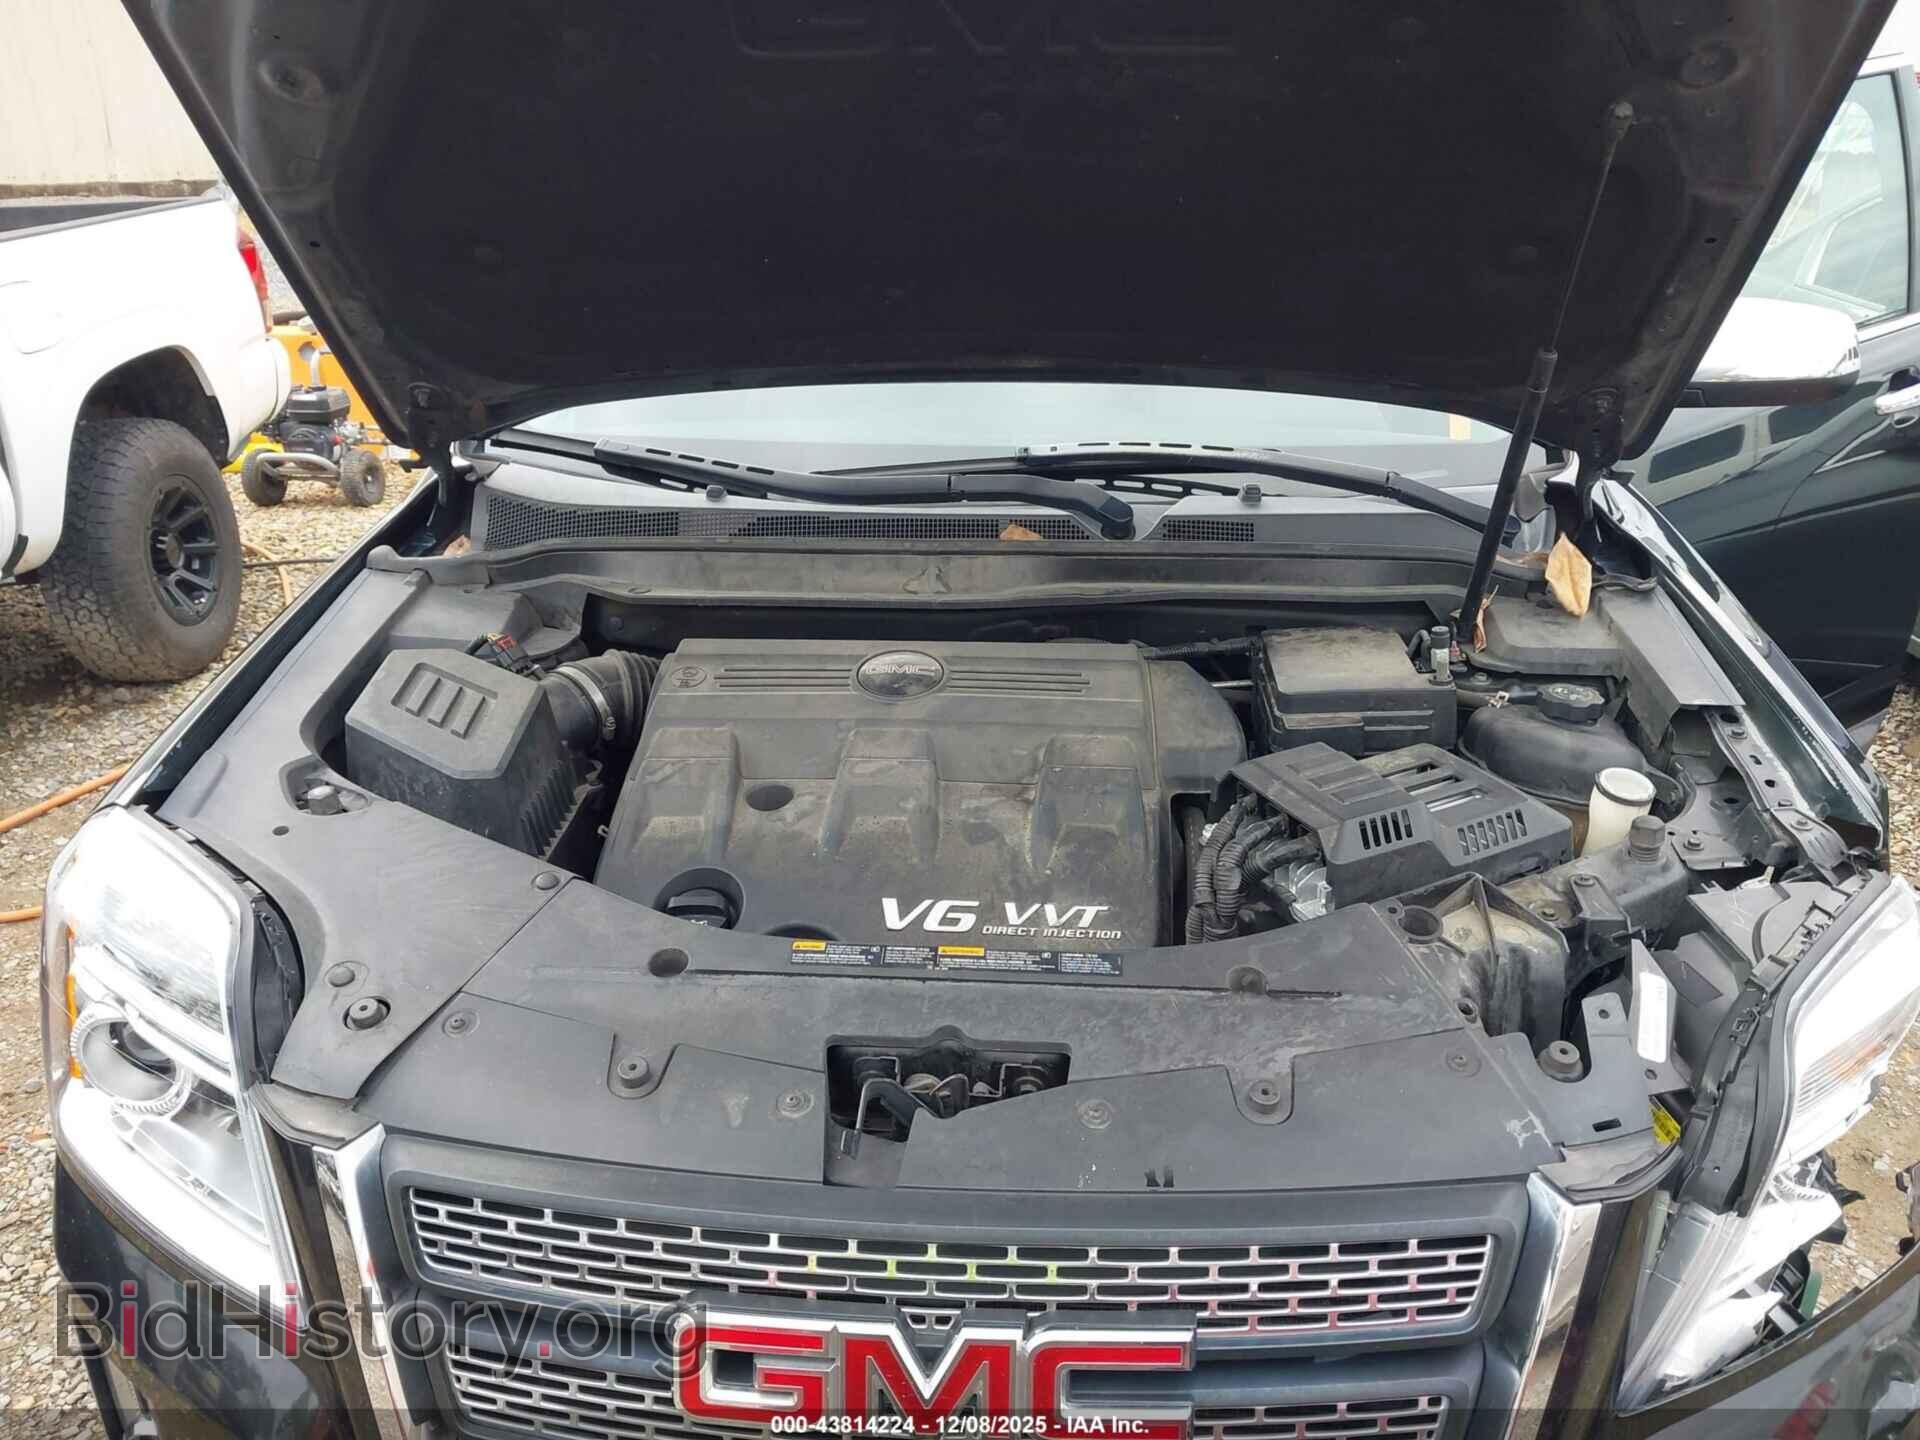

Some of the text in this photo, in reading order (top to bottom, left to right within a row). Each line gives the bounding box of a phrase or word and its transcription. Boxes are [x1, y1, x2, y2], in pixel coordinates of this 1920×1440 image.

[881, 897, 1111, 933] V6 VVT
[981, 924, 1038, 938] DIRECT
[673, 1308, 1195, 1440] GMC
